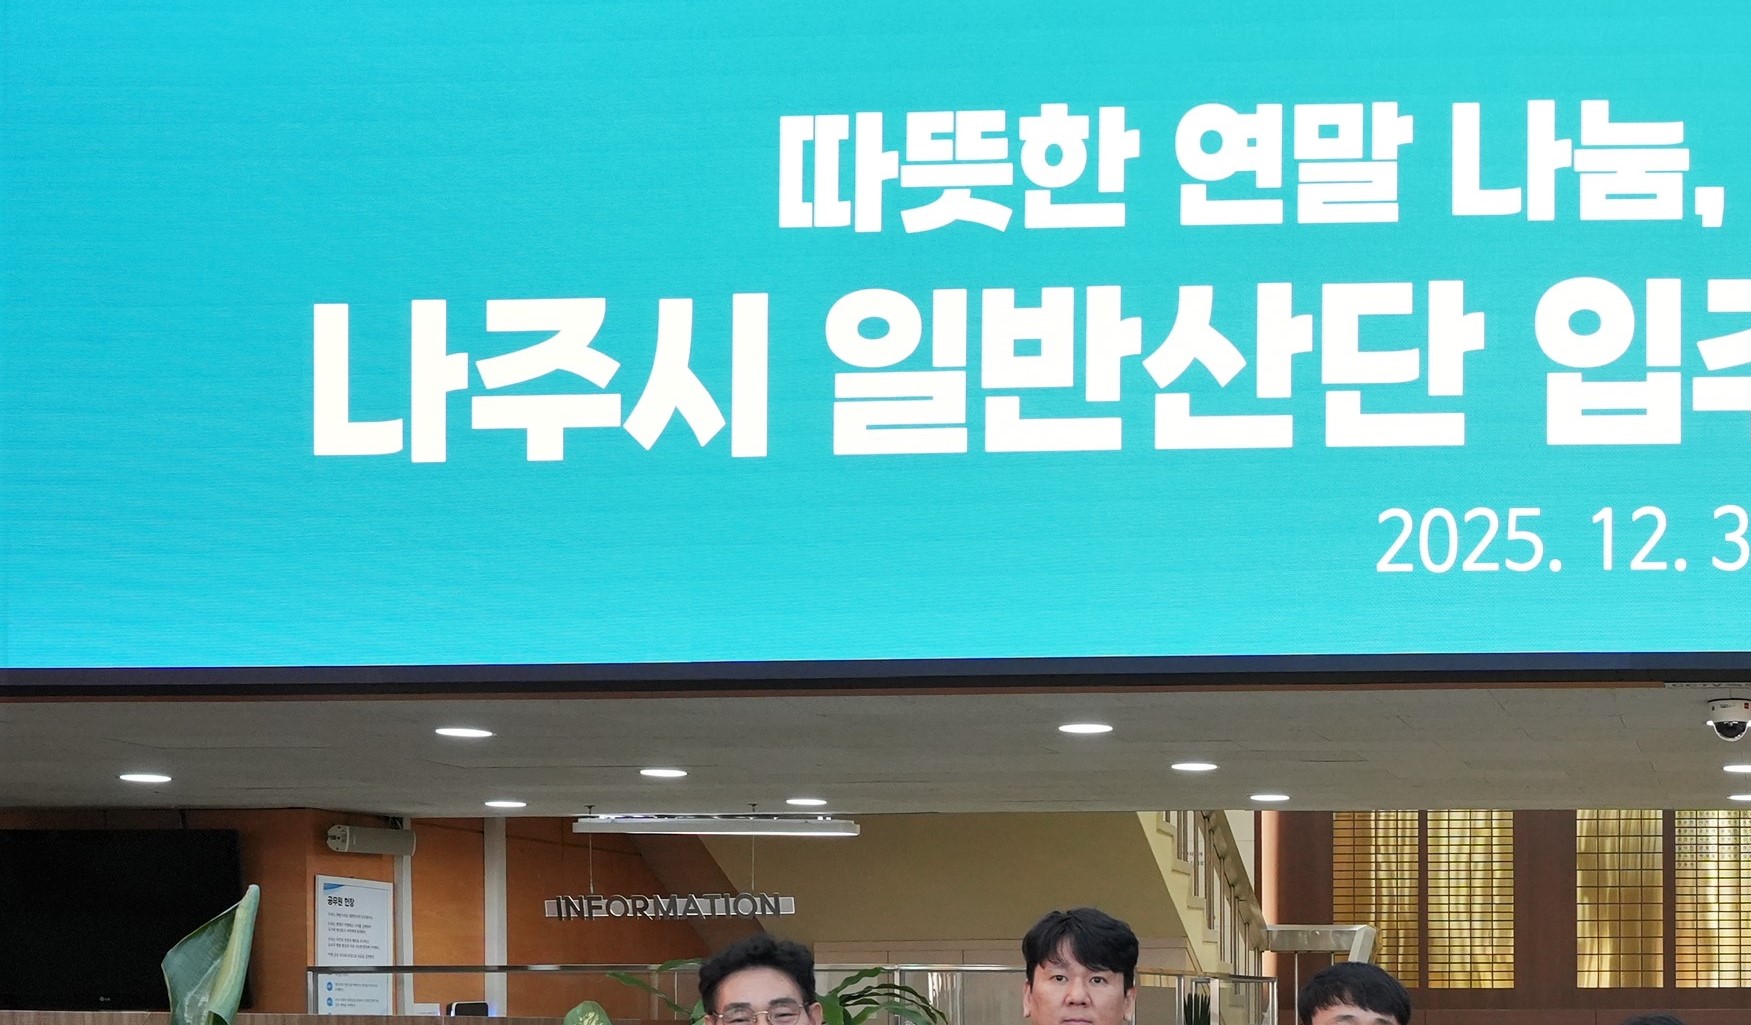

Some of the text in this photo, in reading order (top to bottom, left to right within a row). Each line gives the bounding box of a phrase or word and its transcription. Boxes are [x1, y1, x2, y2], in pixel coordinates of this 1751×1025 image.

[778, 103, 1141, 234] 따뜻한
[1174, 101, 1413, 226] 연말
[1451, 99, 1725, 228] 나눔,
[313, 292, 769, 464] 나주시
[825, 279, 1486, 456] 일반산단
[1376, 506, 1562, 574] 2025.
[1591, 505, 1688, 572] 12.
[556, 893, 781, 920] INFORMATION
